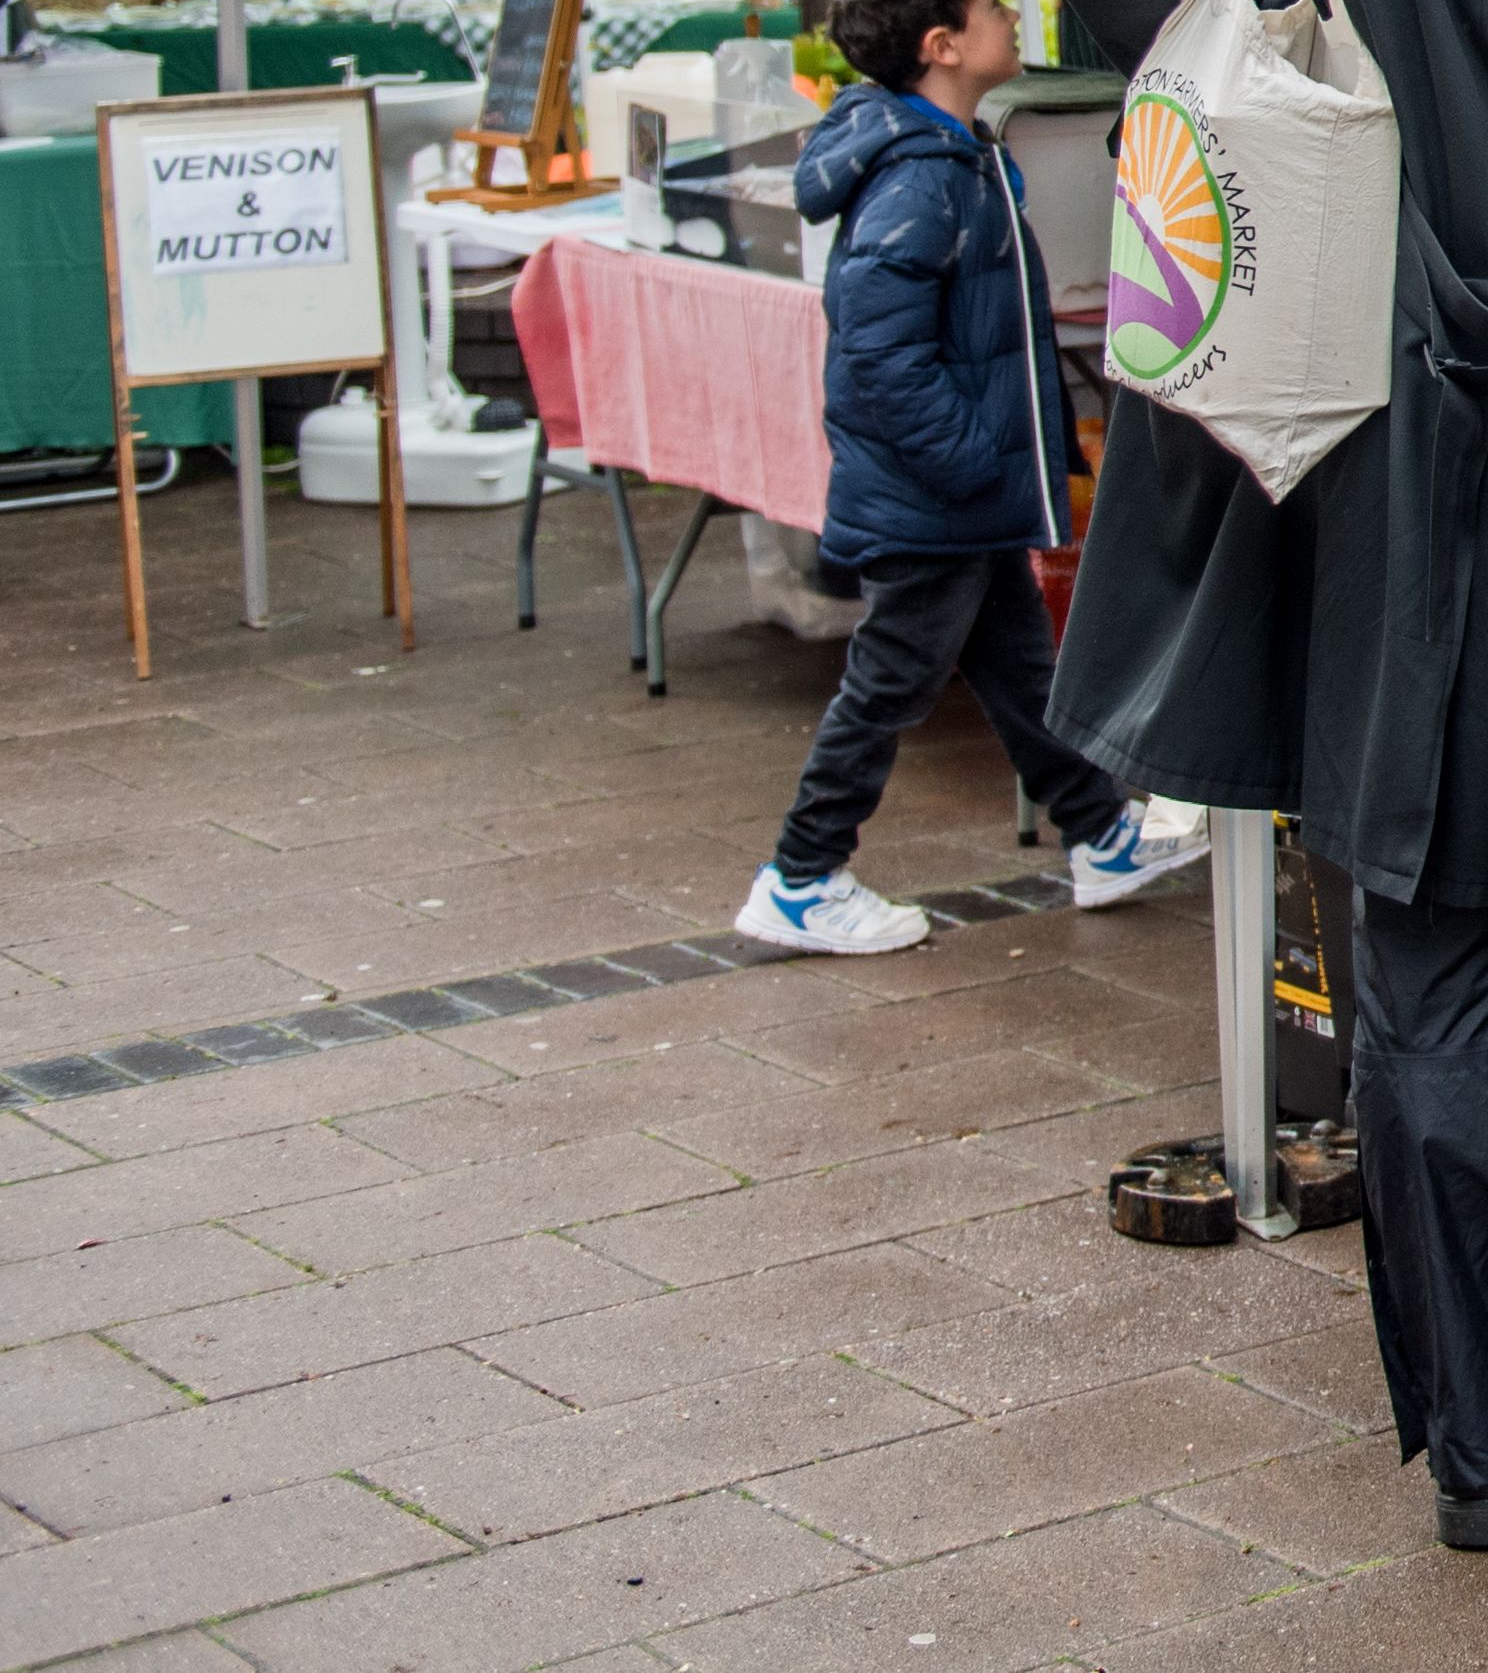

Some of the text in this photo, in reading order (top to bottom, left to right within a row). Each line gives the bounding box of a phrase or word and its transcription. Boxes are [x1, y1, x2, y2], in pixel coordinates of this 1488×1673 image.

[153, 147, 336, 183] VENISON
[1128, 68, 1174, 100] PTON
[1216, 171, 1257, 297] MARKET
[236, 190, 261, 217] &
[157, 227, 332, 263] MUTTON
